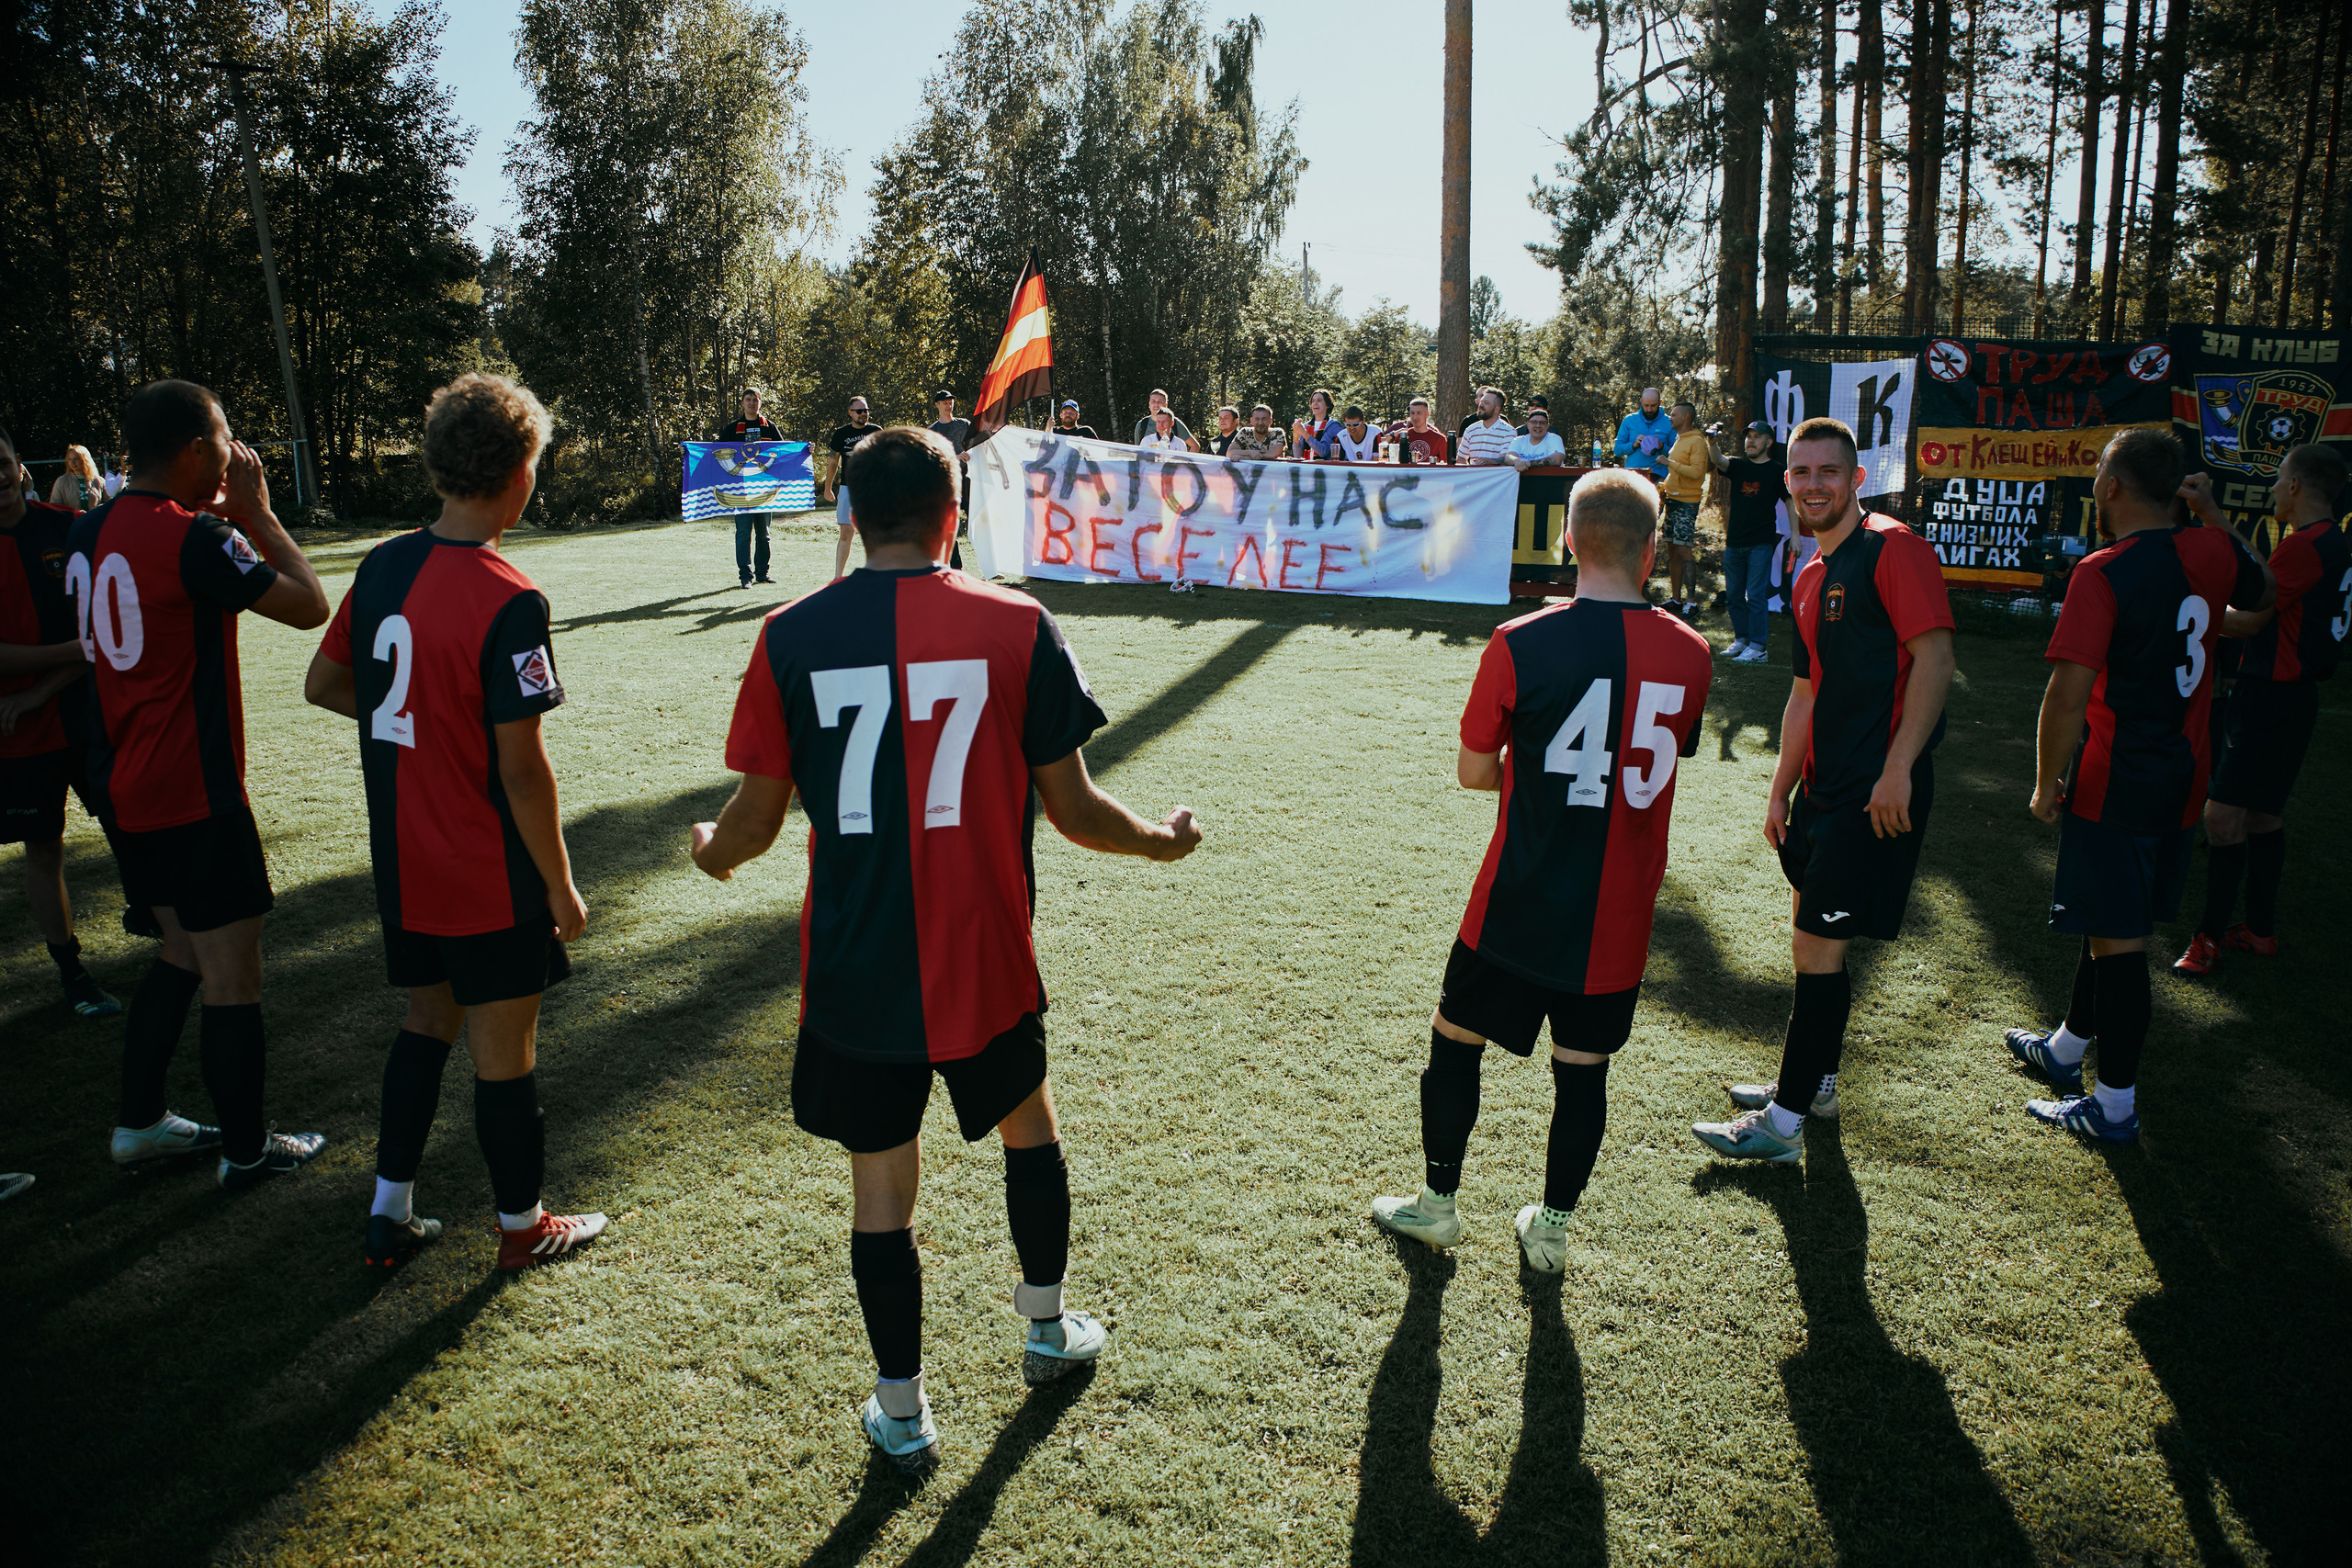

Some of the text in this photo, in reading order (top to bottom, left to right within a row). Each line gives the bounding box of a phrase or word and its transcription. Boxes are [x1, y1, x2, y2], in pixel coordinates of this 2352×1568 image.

[1976, 343, 2109, 385] ТРУД
[2200, 330, 2340, 364] ЗА КЛУБ
[1976, 385, 2108, 429] ПАША
[2261, 389, 2322, 412] ТРУД
[2279, 378, 2316, 394] 1952
[2253, 453, 2281, 466] ПАШ
[1288, 467, 1430, 530] НАС
[1942, 478, 2046, 505] ДУША
[1932, 502, 2038, 525] ФУТБОЛА
[1041, 501, 1354, 592] ВЕСЕЛЕЕ
[1934, 544, 2021, 568] ЛИГАХ
[65, 551, 144, 671] 20
[2176, 594, 2211, 698] 3
[371, 613, 415, 749] 2
[809, 659, 989, 835] 77
[1544, 678, 1686, 809] 45
